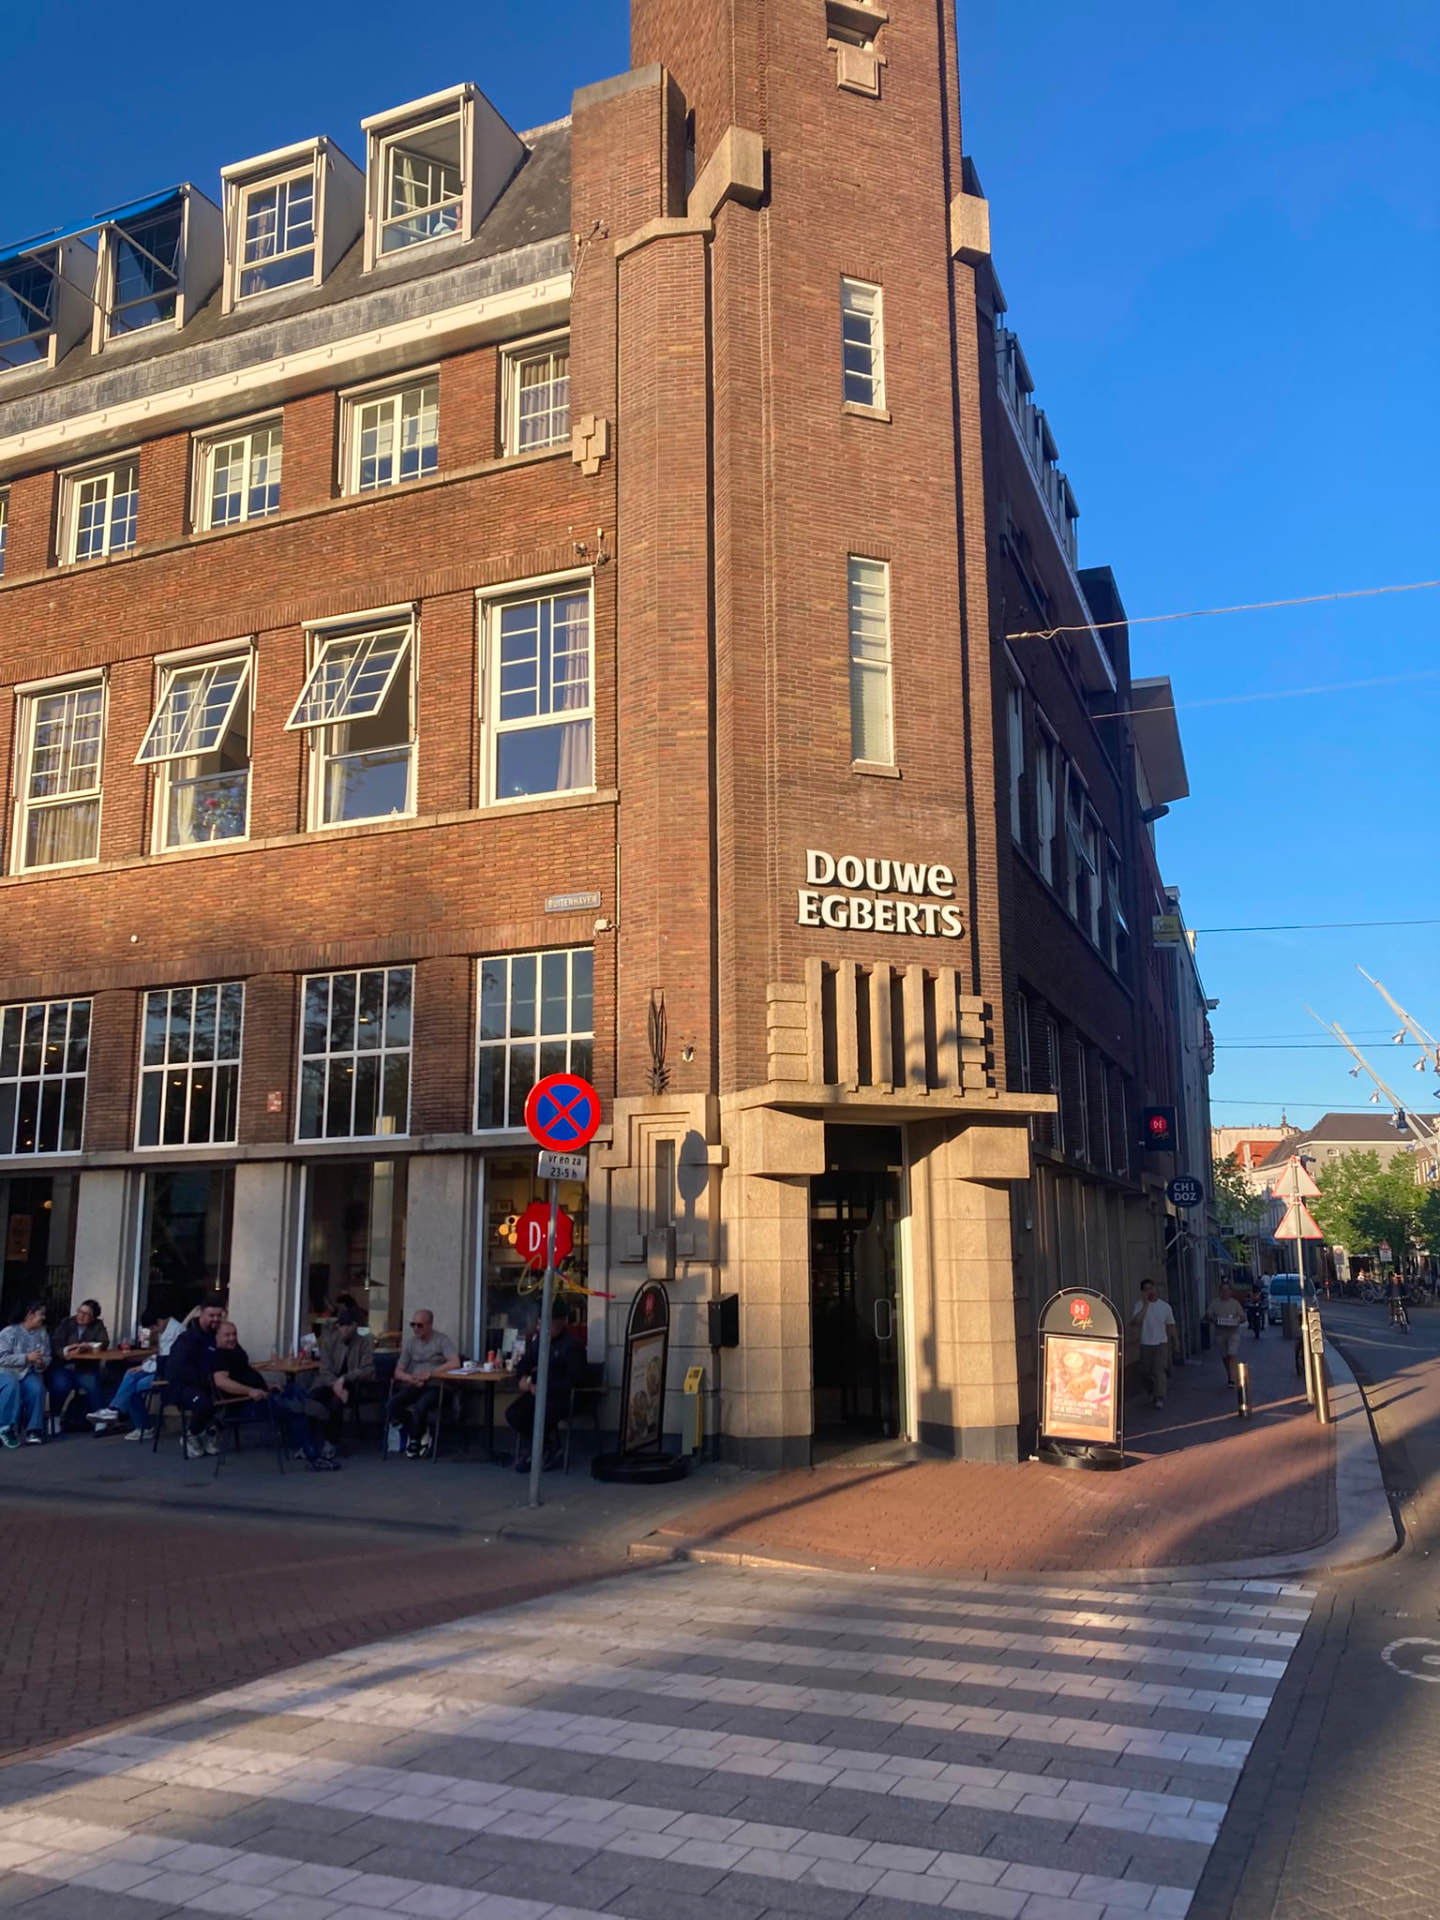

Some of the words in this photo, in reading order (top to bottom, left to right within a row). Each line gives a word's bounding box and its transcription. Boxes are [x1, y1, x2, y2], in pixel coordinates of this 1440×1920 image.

[547, 895, 598, 908] BUITENHAVEN
[797, 889, 963, 938] EGBERTS
[548, 1155, 556, 1163] vr
[572, 1158, 582, 1166] za
[550, 1166, 569, 1177] 23-5
[571, 1168, 578, 1178] h
[1173, 1182, 1195, 1191] CHI
[1174, 1192, 1197, 1201] DOZ
